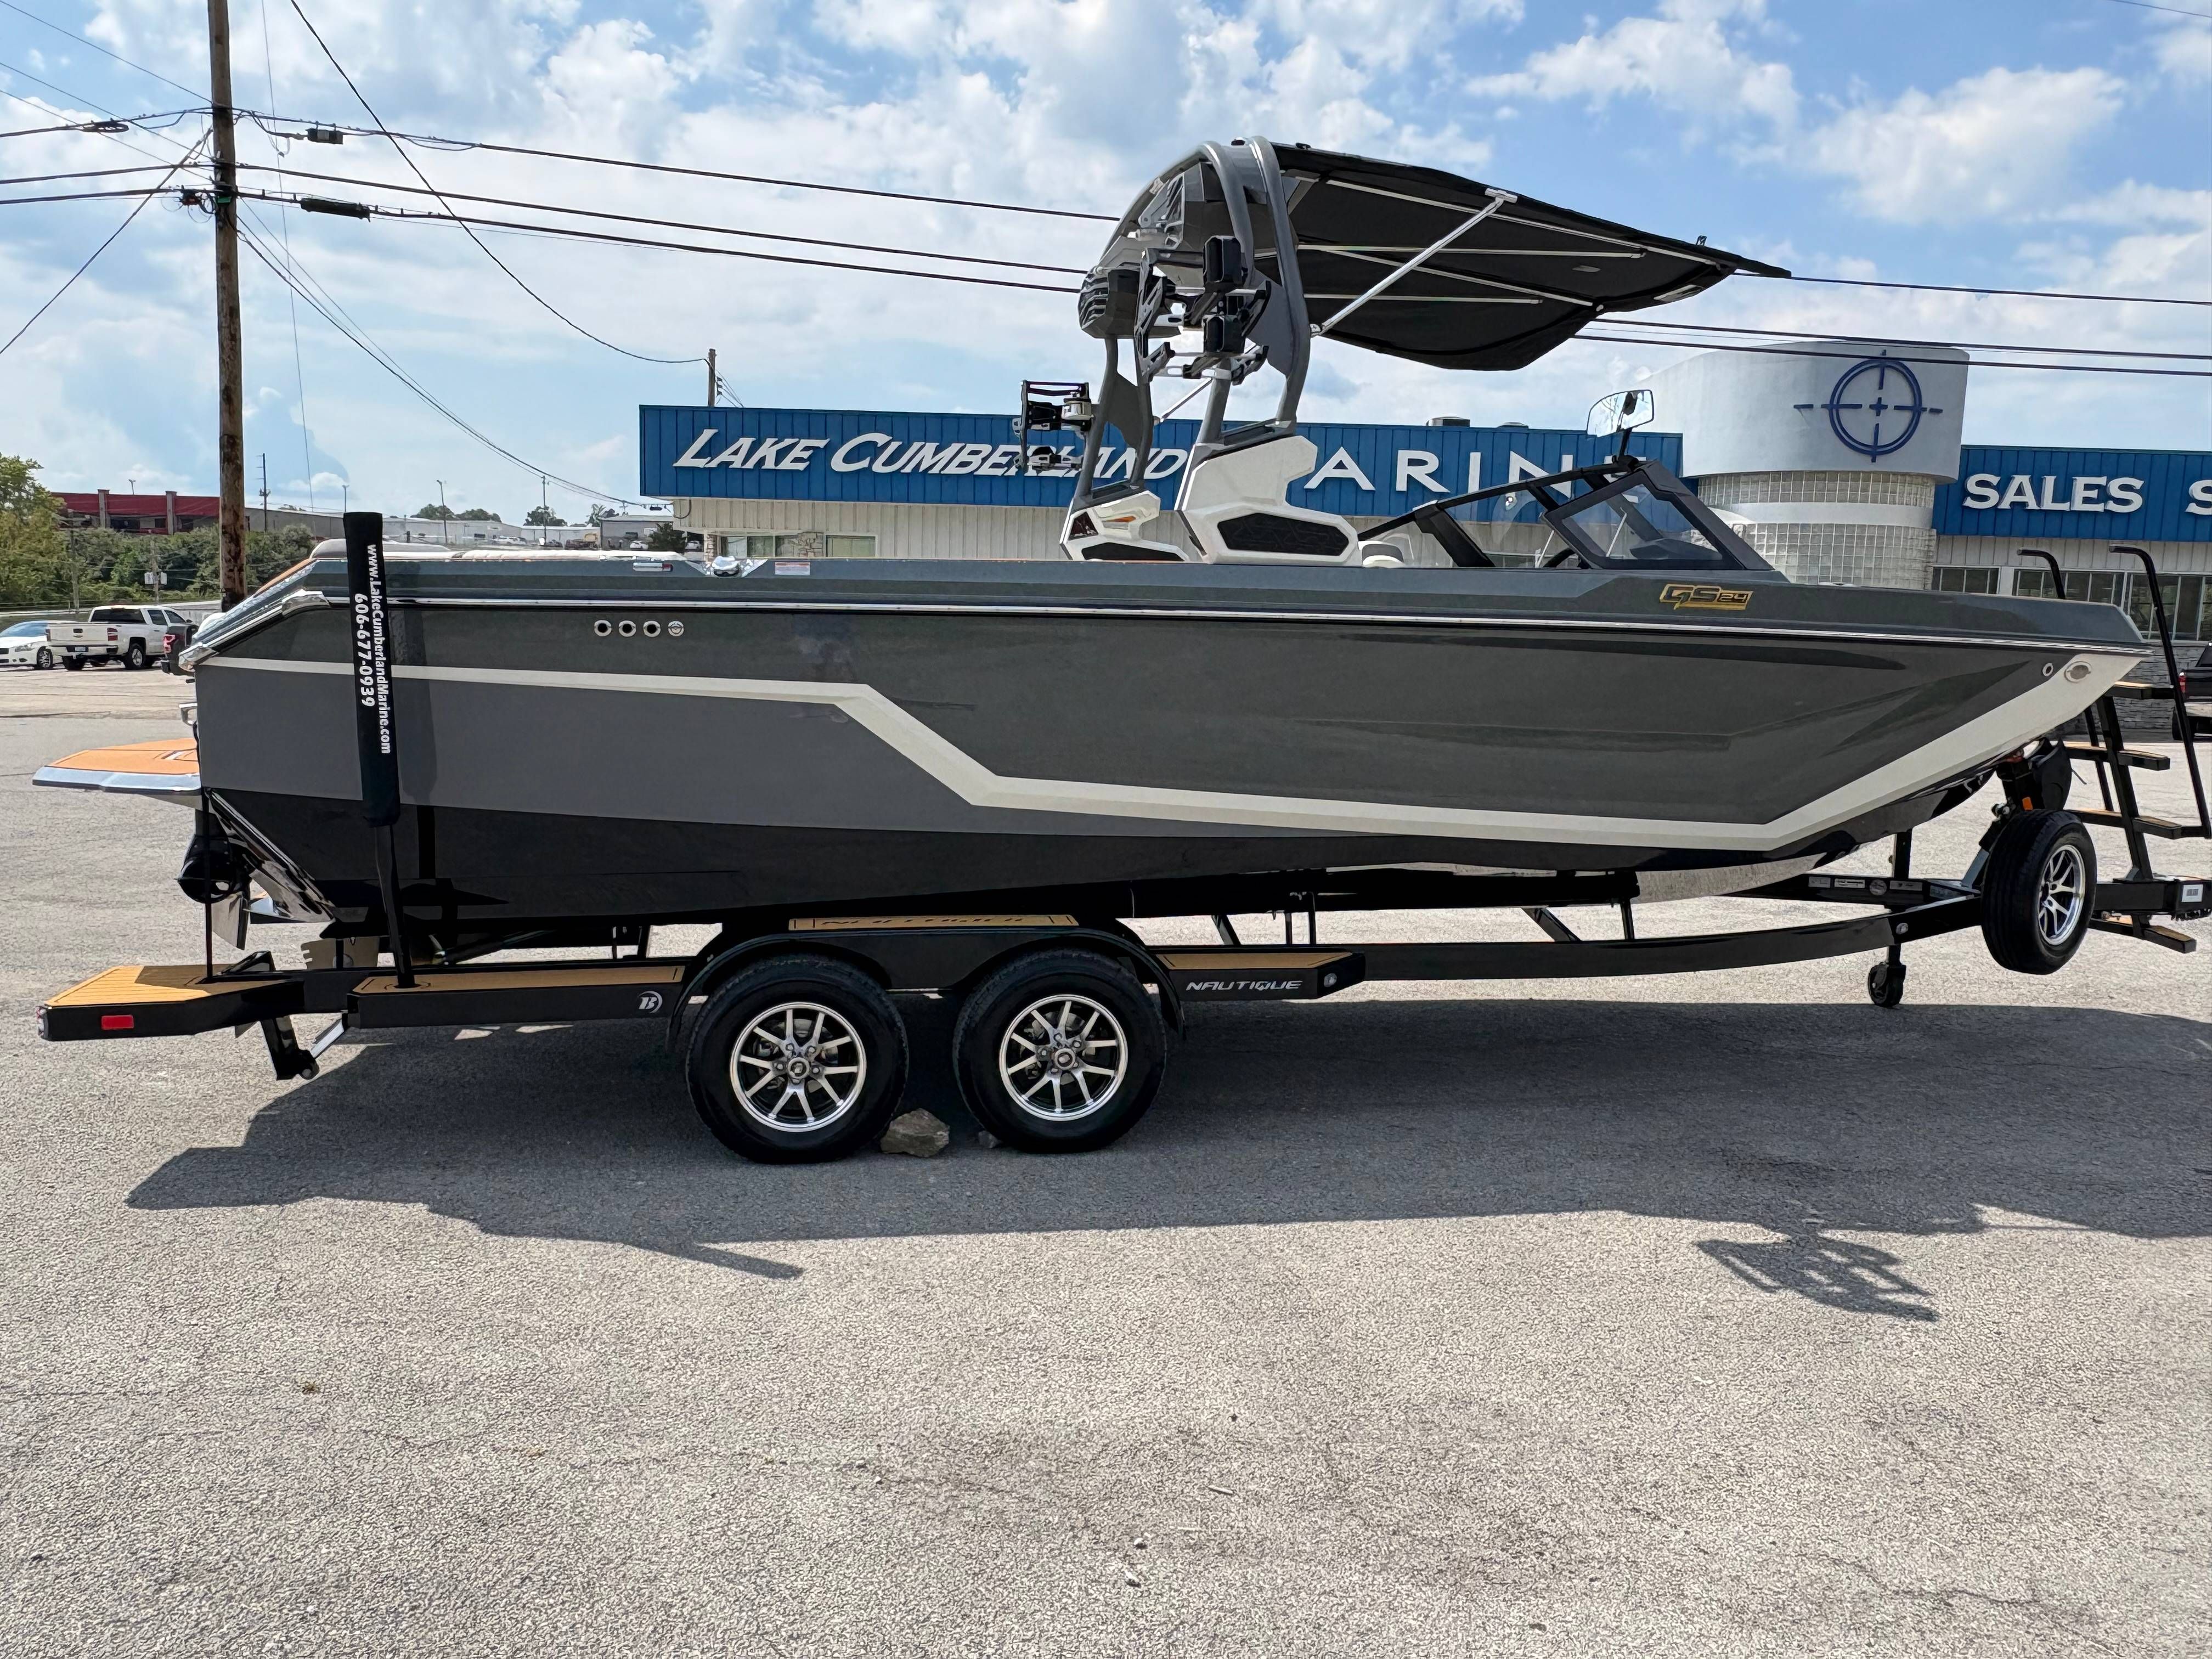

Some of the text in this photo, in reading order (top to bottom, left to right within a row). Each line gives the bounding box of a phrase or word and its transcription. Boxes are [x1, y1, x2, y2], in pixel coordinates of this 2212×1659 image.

[673, 428, 830, 471] LAKE
[1962, 473, 2145, 513] SALES
[354, 593, 376, 707] 606-677-0939
[367, 544, 391, 754] www.LakeCumberlandMarine.com
[1186, 980, 1304, 991] NAUTIQUE
